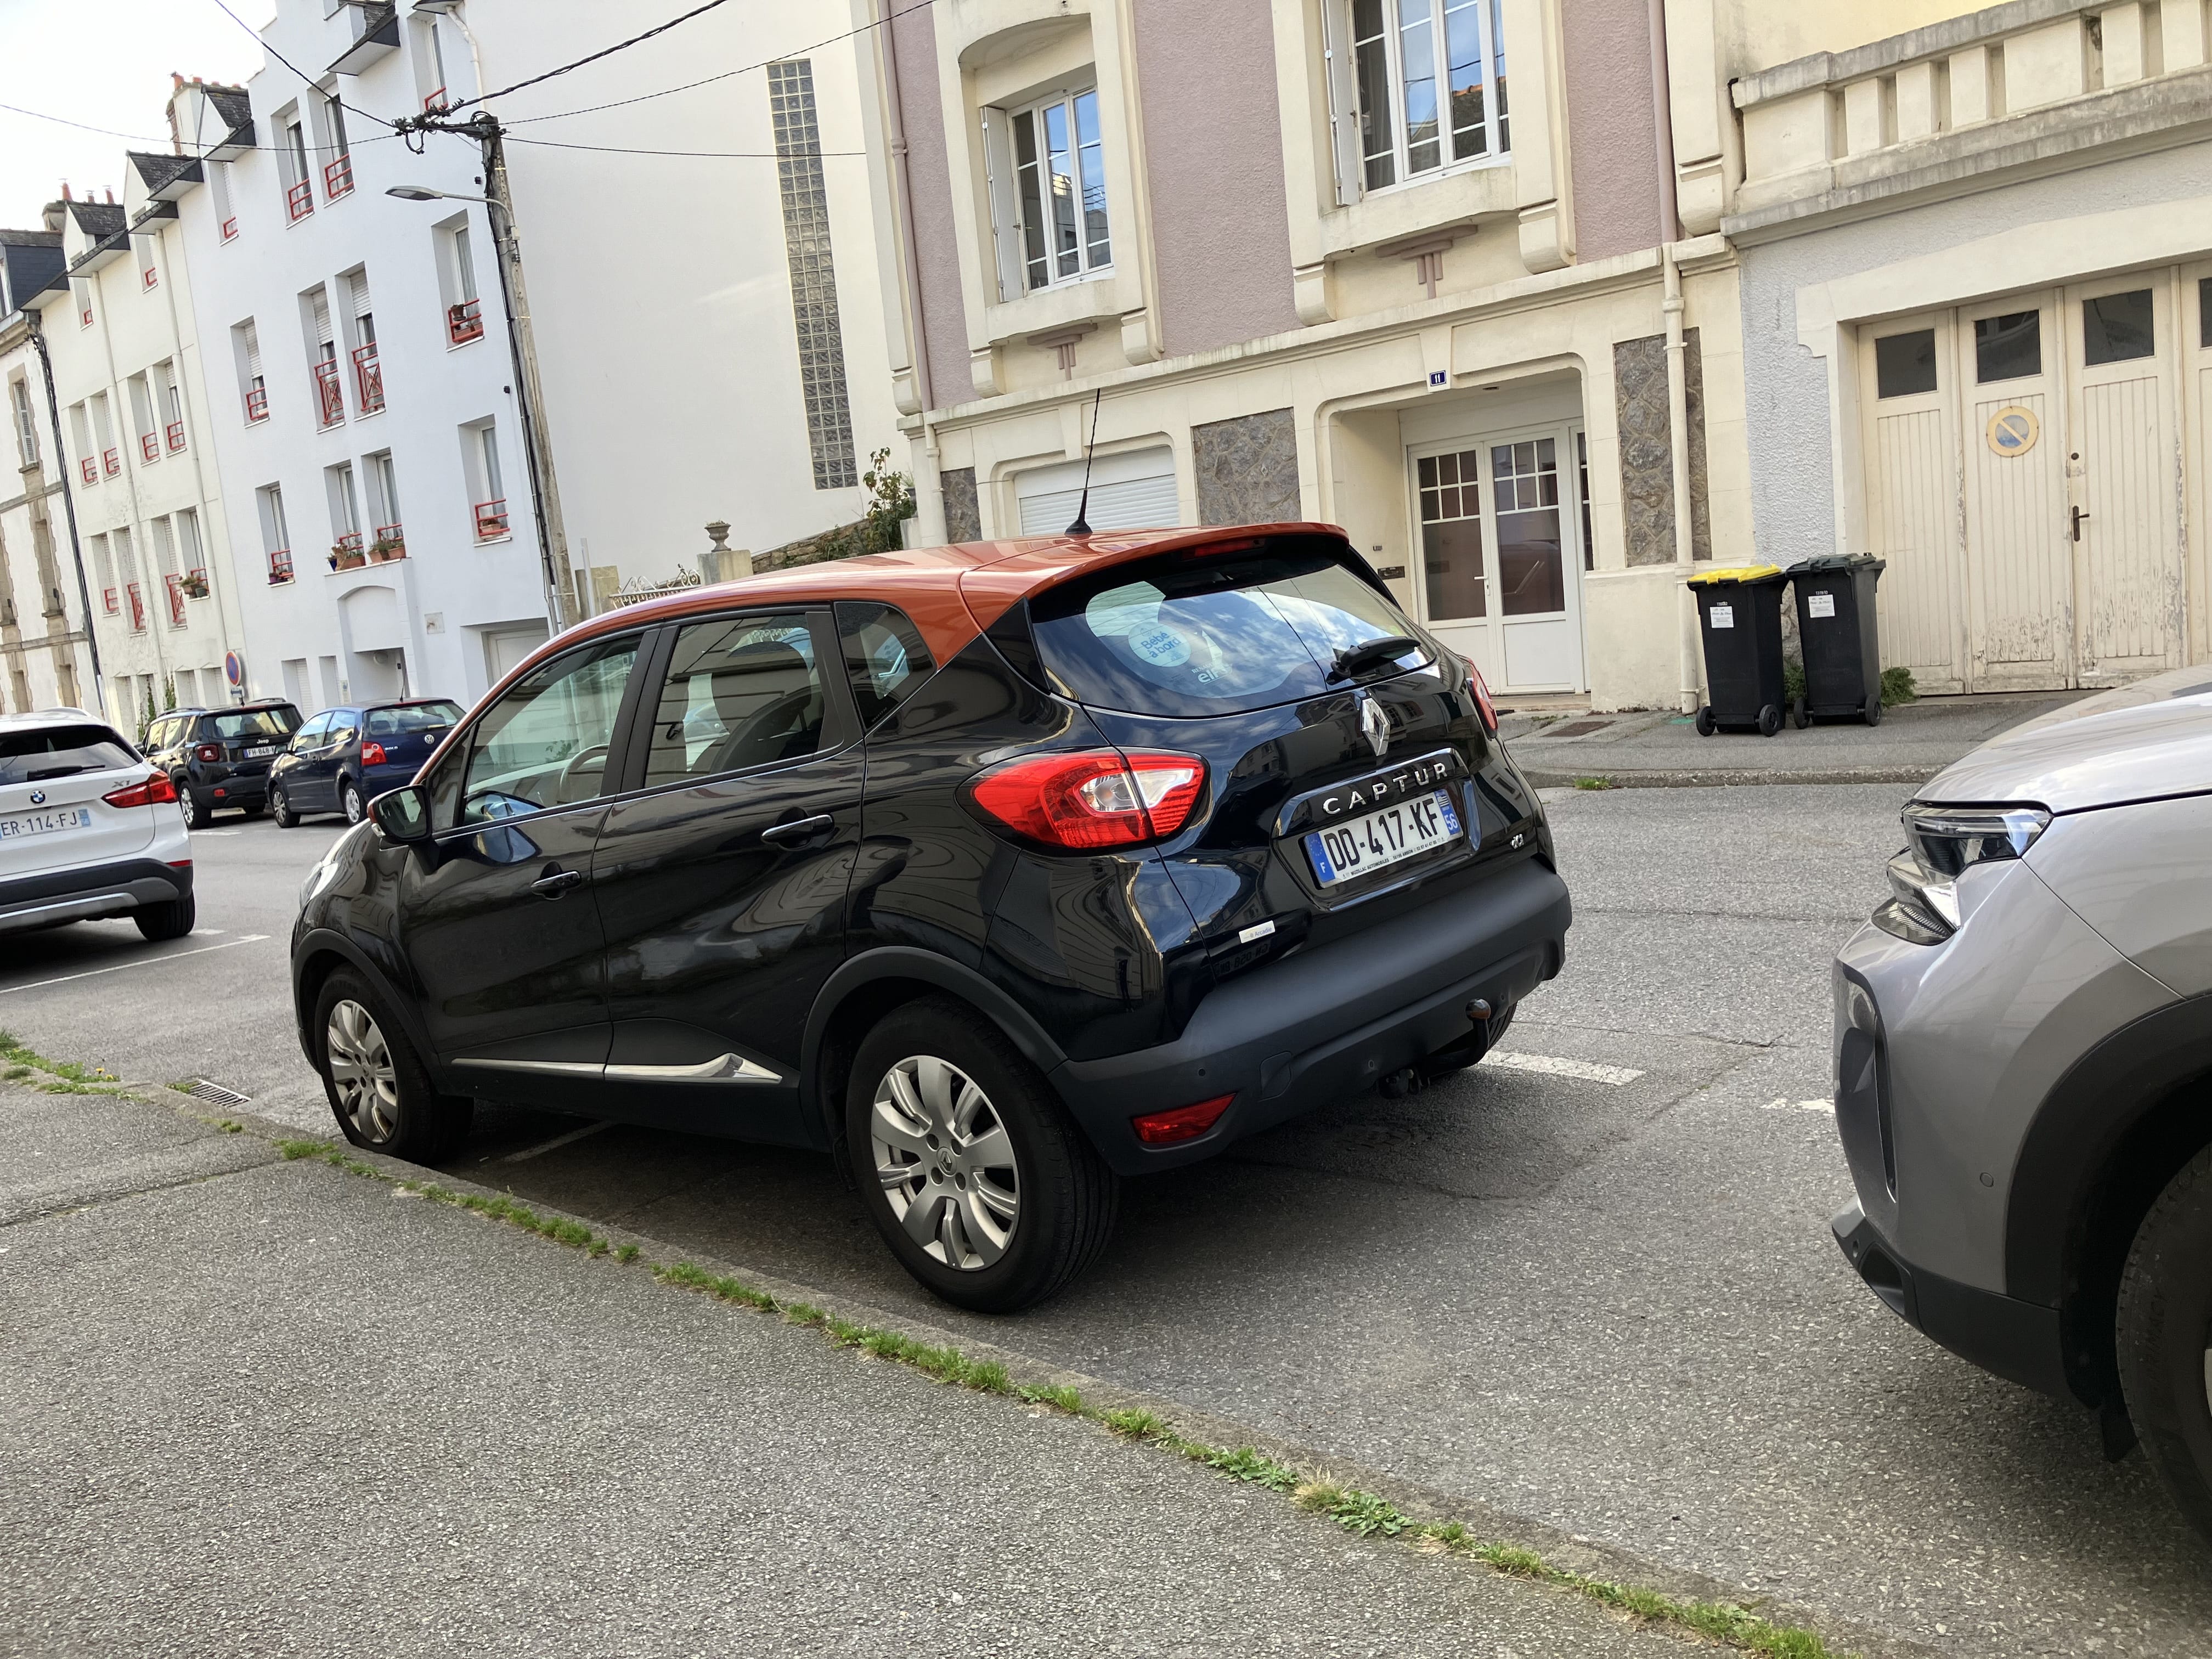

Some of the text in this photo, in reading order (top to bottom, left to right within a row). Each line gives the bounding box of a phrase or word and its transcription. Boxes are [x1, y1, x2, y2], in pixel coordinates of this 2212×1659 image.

[1435, 374, 1441, 383] 11
[1141, 631, 1170, 649] Bébé
[1147, 650, 1158, 658] à
[1154, 636, 1181, 653] bord
[111, 780, 131, 788] X1
[1323, 763, 1448, 814] CAPTUR
[1, 812, 77, 836] ER-114-FJ
[1444, 813, 1458, 830] 56
[1324, 798, 1438, 871] DD-417-KF
[1320, 862, 1325, 873] F
[1255, 927, 1272, 936] Arcadie
